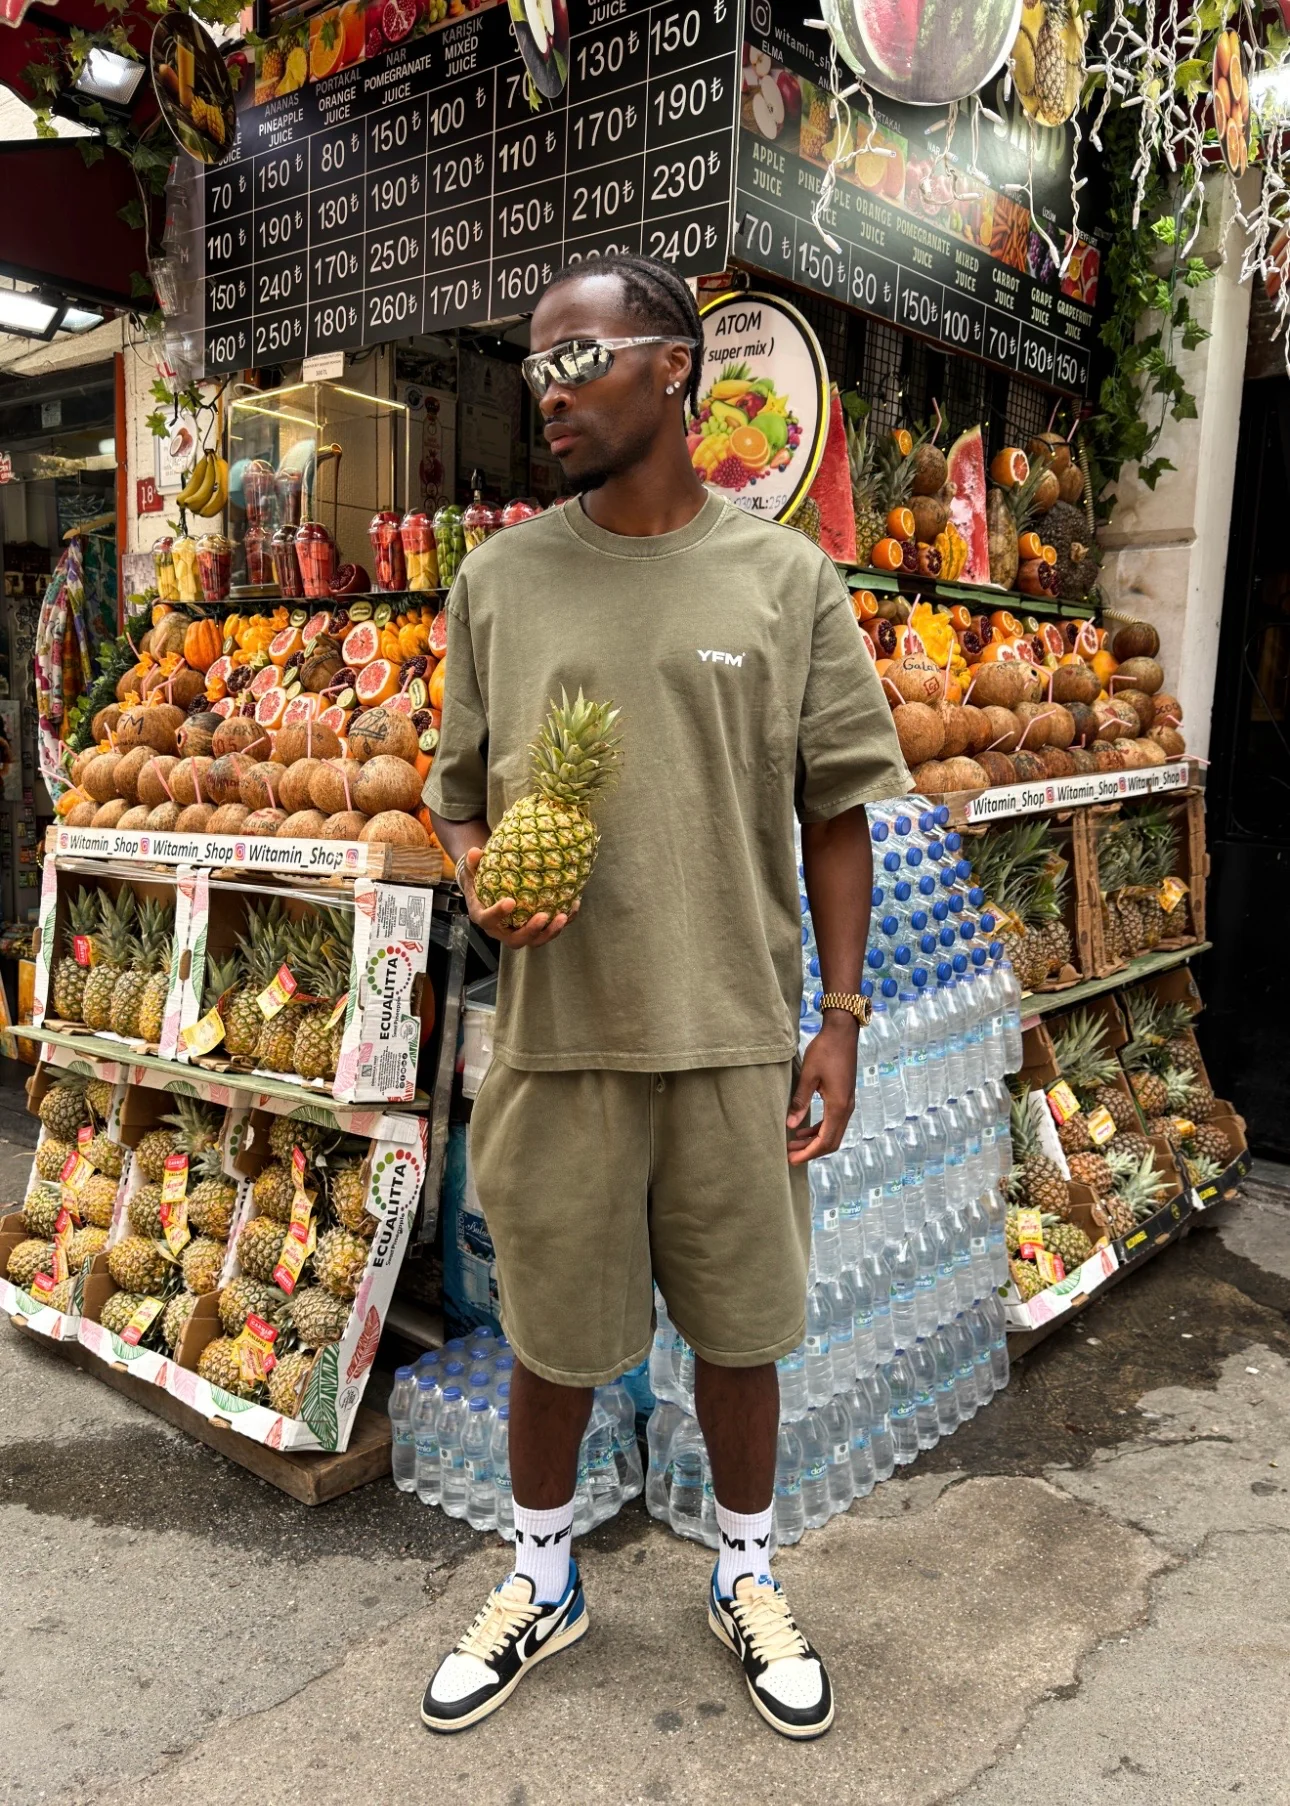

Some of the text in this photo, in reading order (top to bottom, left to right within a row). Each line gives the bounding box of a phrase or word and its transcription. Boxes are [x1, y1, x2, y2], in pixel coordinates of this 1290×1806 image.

[588, 0, 627, 25] JUICE
[442, 16, 483, 45] KARIŞIK
[386, 48, 407, 67] NAR
[444, 35, 479, 61] MIXED
[761, 39, 784, 63] ELMA
[774, 26, 843, 79] witamin_shp
[364, 54, 432, 92] POMEGRANATE
[445, 54, 477, 78] JUICE
[315, 68, 362, 97] PORTAKAL
[382, 83, 411, 105] JUICE
[264, 92, 299, 118] ANANAS
[318, 86, 356, 112] ORANGE
[258, 108, 304, 137] PINEAPPLE
[323, 107, 351, 126] JUICE
[871, 106, 902, 134] ORTAKAL
[268, 127, 293, 148] JUICE
[752, 142, 786, 174] APPLE
[752, 168, 783, 197] JUICE
[798, 169, 851, 210] PINEPLE
[810, 200, 837, 227] JICE
[856, 196, 893, 227] ORANGE
[860, 221, 886, 247] JUICE
[896, 218, 951, 257] POMEGRANATE
[912, 247, 933, 269] JUICE
[955, 249, 979, 273] MIXED
[955, 270, 976, 292] JUICE
[992, 267, 1020, 293] CARROT
[995, 289, 1015, 310] JUICE
[1031, 287, 1053, 309] GRAPE
[715, 310, 762, 337] ATOM
[1031, 306, 1050, 326] JUICE
[1056, 299, 1093, 328] GRAPEFRUIT
[1064, 322, 1082, 341] JUICE
[696, 649, 743, 668] YFM
[973, 789, 1045, 816] Witamin_Shop
[1057, 776, 1119, 801] Witamin_Shop
[69, 834, 343, 870] Witamin_Shop Witamin_Shop Witamin_Shop
[380, 957, 399, 1040] ECUALITTA
[372, 1164, 407, 1268] ECUALITTA
[530, 1521, 573, 1547] YF
